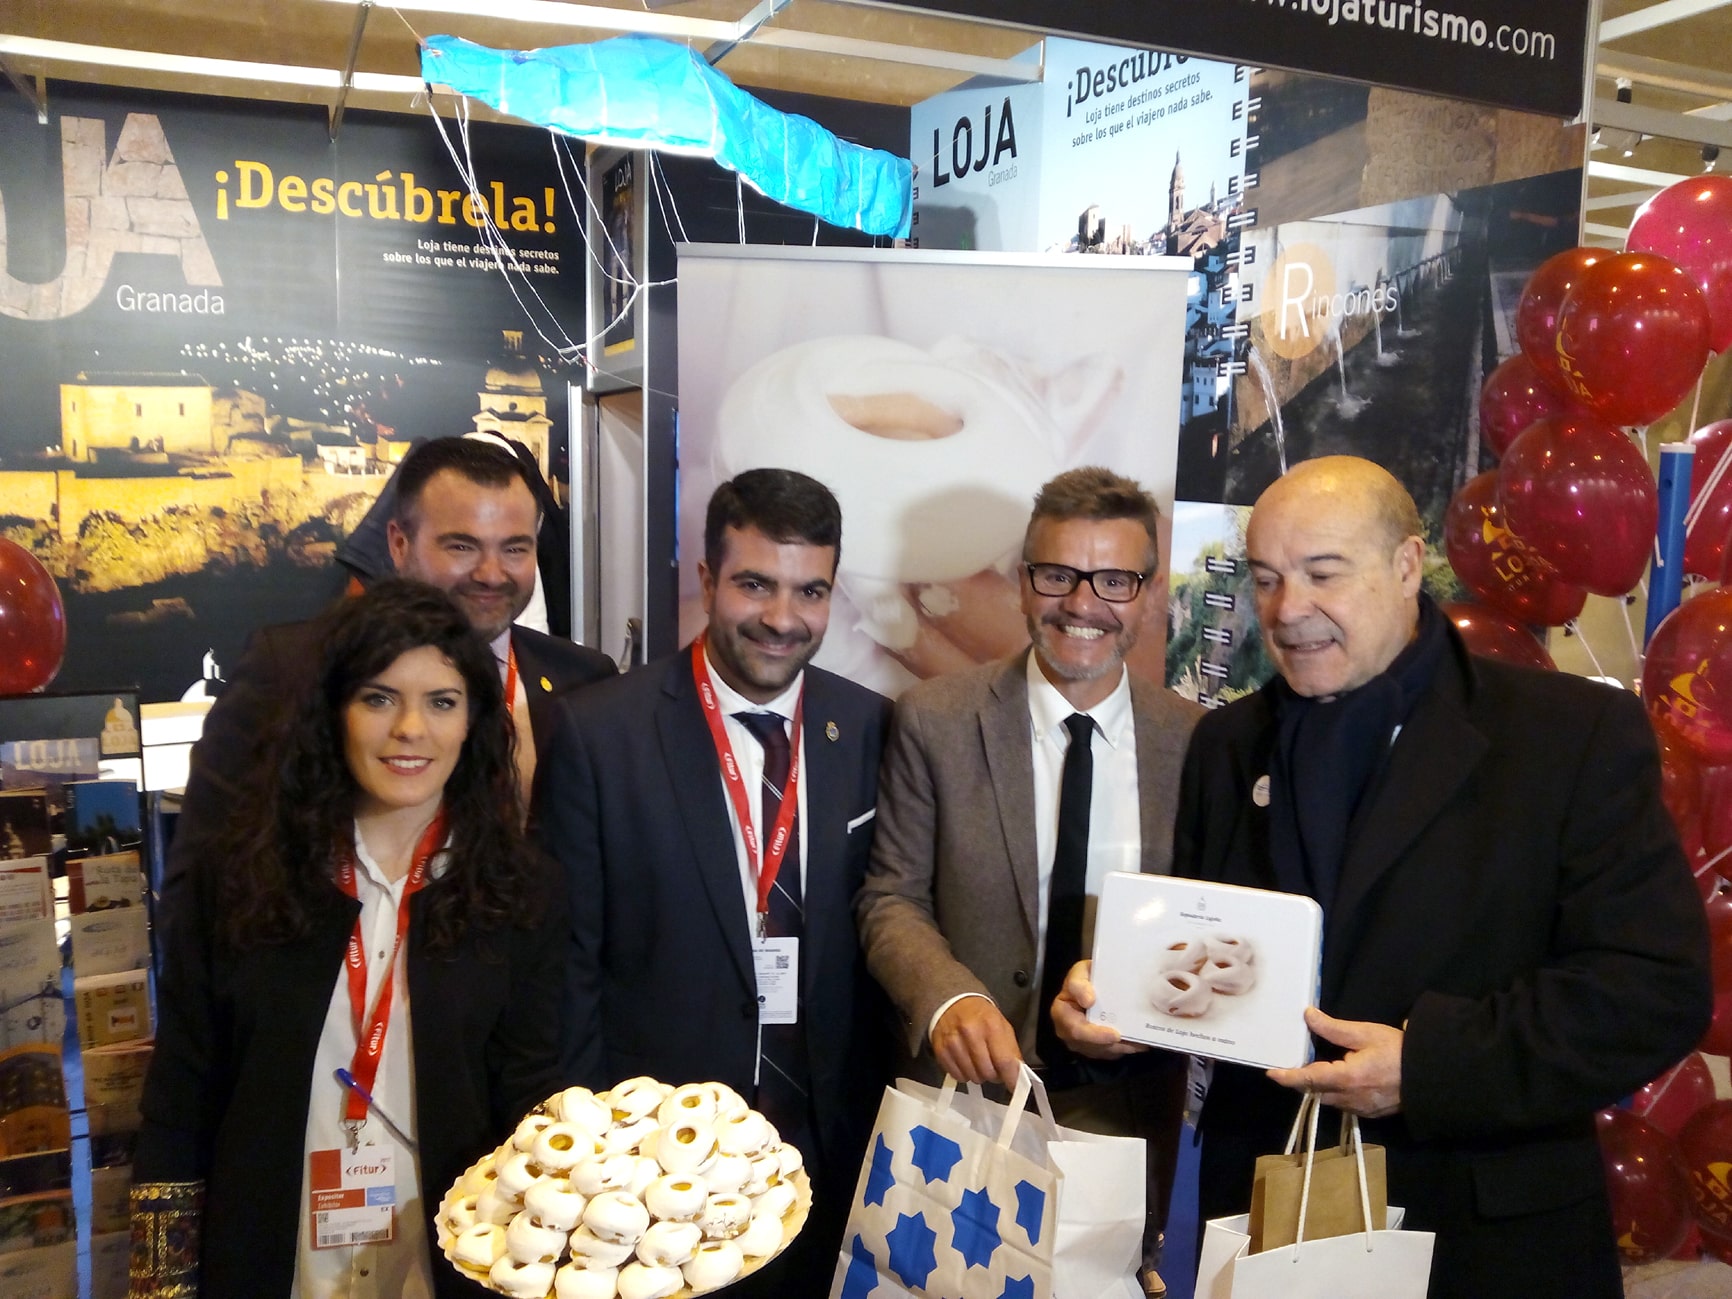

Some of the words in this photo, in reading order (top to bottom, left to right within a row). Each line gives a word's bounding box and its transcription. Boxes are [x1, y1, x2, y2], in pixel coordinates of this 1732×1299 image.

[1072, 129, 1094, 148] sobre
[1095, 127, 1107, 141] los
[1109, 120, 1124, 138] que
[1126, 116, 1134, 130] el
[1136, 105, 1165, 130] viajero
[1167, 101, 1188, 118] nada
[1190, 89, 1214, 107] sabe.
[1085, 108, 1102, 125] Loja
[1104, 102, 1125, 118] tiene
[1127, 86, 1162, 109] destinos
[1165, 72, 1201, 95] secretos
[933, 96, 1017, 188] LOJA
[215, 160, 556, 234] ¡Descúbrela!
[988, 164, 1018, 187] Granada
[0, 112, 224, 320] JA
[383, 252, 413, 264] sobre
[415, 253, 431, 265] los
[434, 257, 456, 269] que
[456, 256, 467, 268] el
[507, 260, 531, 272] nada
[533, 263, 560, 275] sabe.
[417, 239, 440, 253] Loja
[443, 241, 469, 255] tiene
[473, 243, 516, 256] destinos
[519, 249, 560, 260] secretos
[116, 284, 225, 315] Granada
[1280, 262, 1399, 341] Rincones
